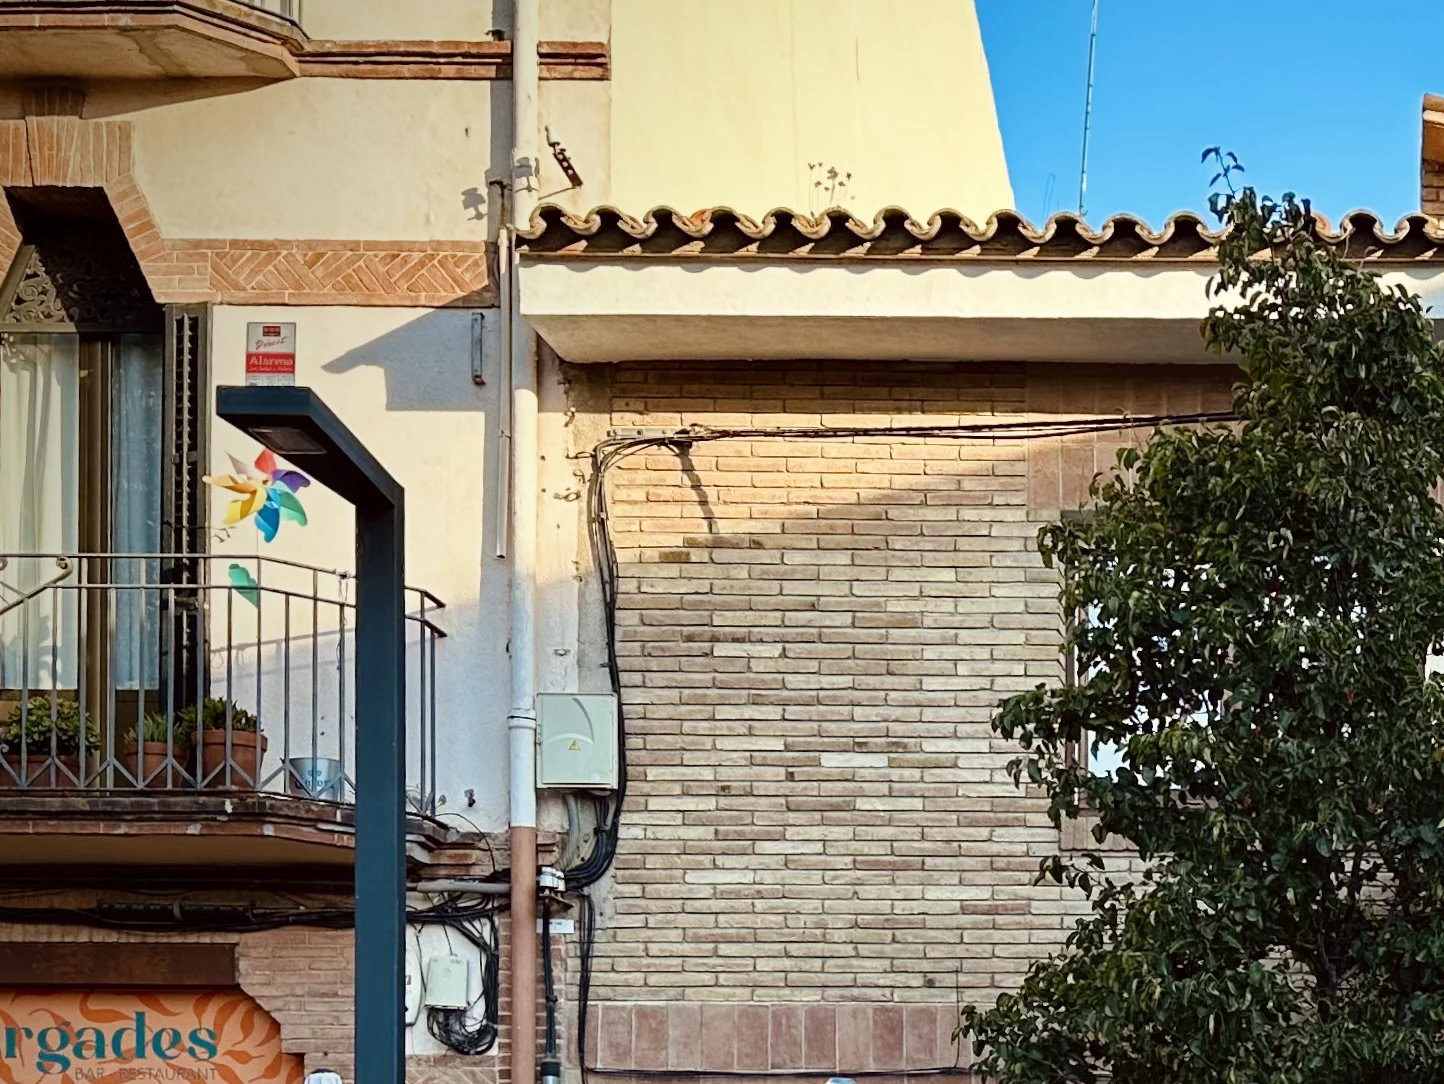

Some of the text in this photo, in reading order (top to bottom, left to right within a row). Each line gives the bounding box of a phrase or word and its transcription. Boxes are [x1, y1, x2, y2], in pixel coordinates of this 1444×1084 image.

[5, 1011, 218, 1075] rgades
[75, 1068, 217, 1081] BAR RESTAURANT
